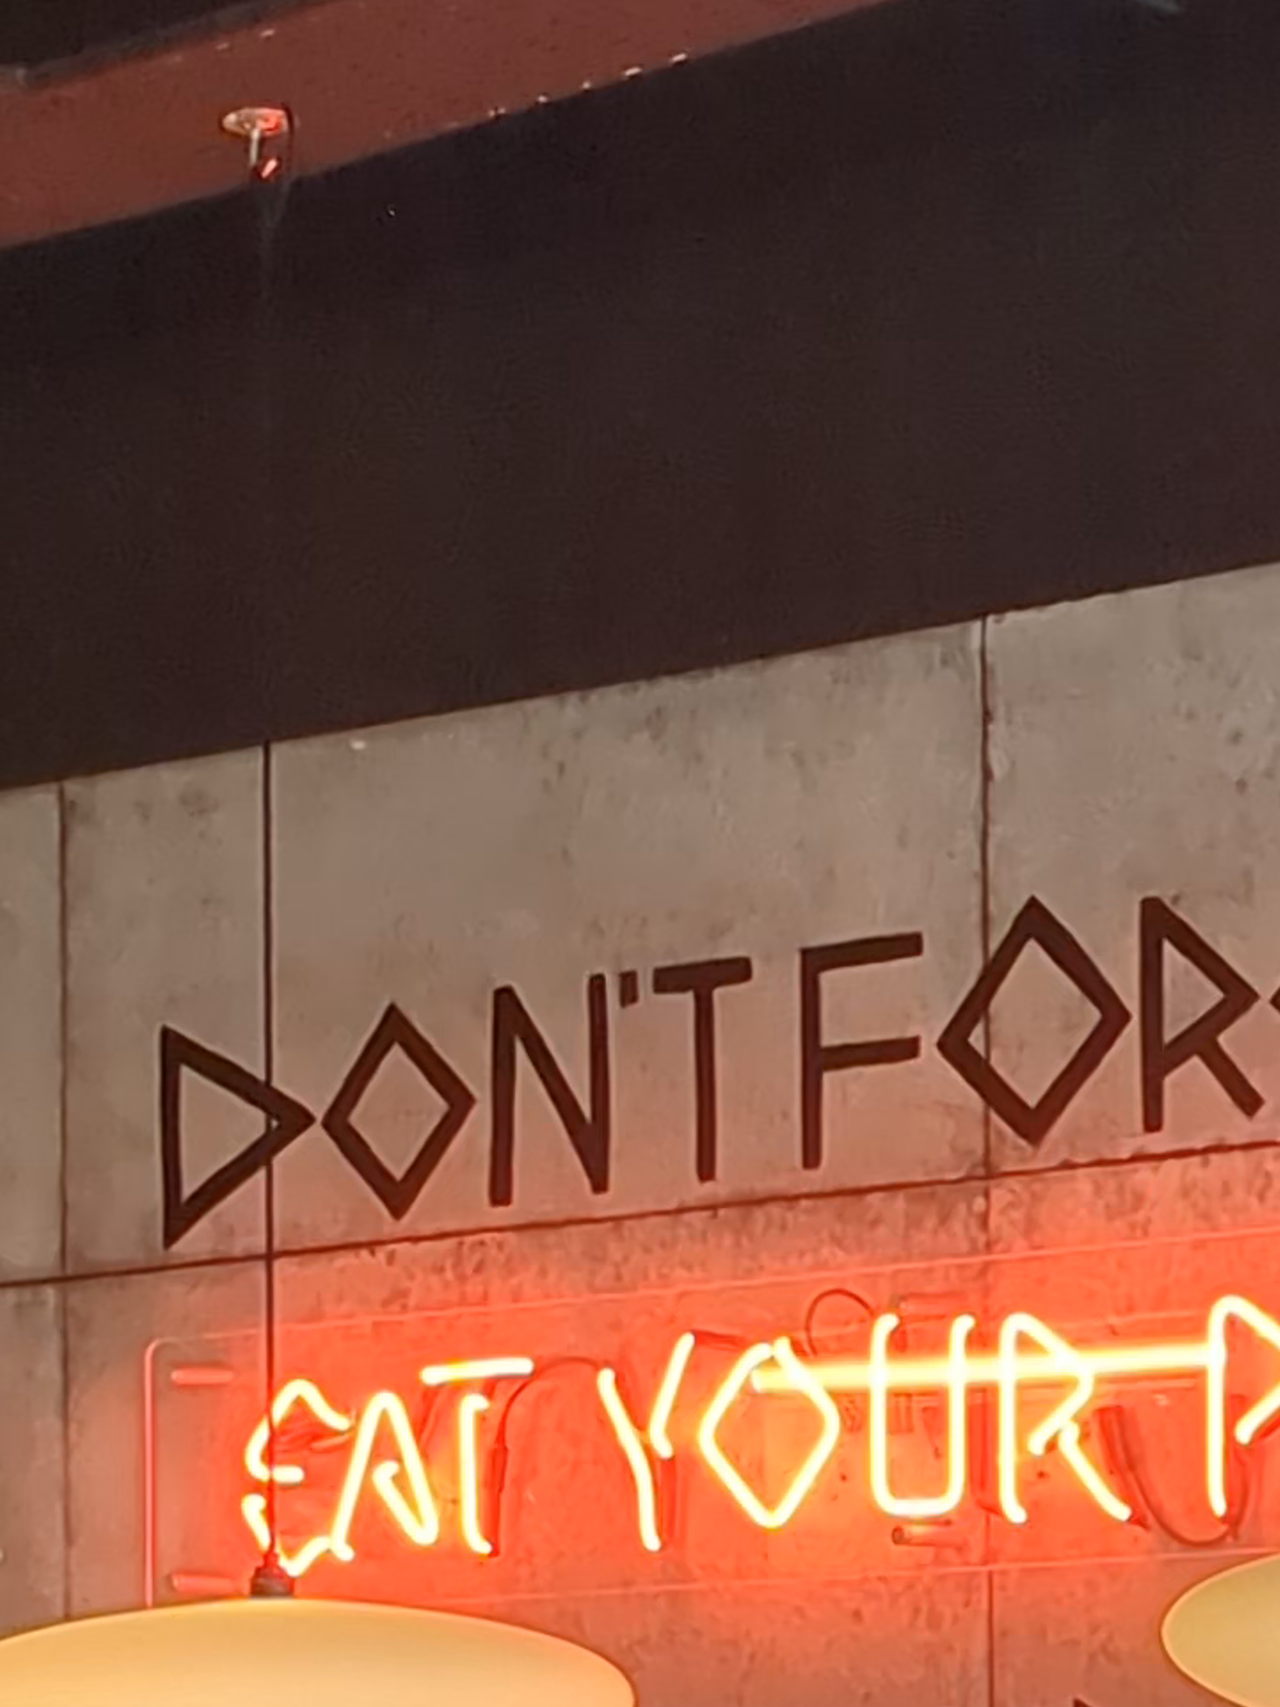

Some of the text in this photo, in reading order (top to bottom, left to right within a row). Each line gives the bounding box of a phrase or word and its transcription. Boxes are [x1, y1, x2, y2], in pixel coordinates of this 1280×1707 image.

[159, 956, 752, 1251] DON'T
[240, 1357, 535, 1577] EAT
[596, 1310, 1132, 1553] YOUR
